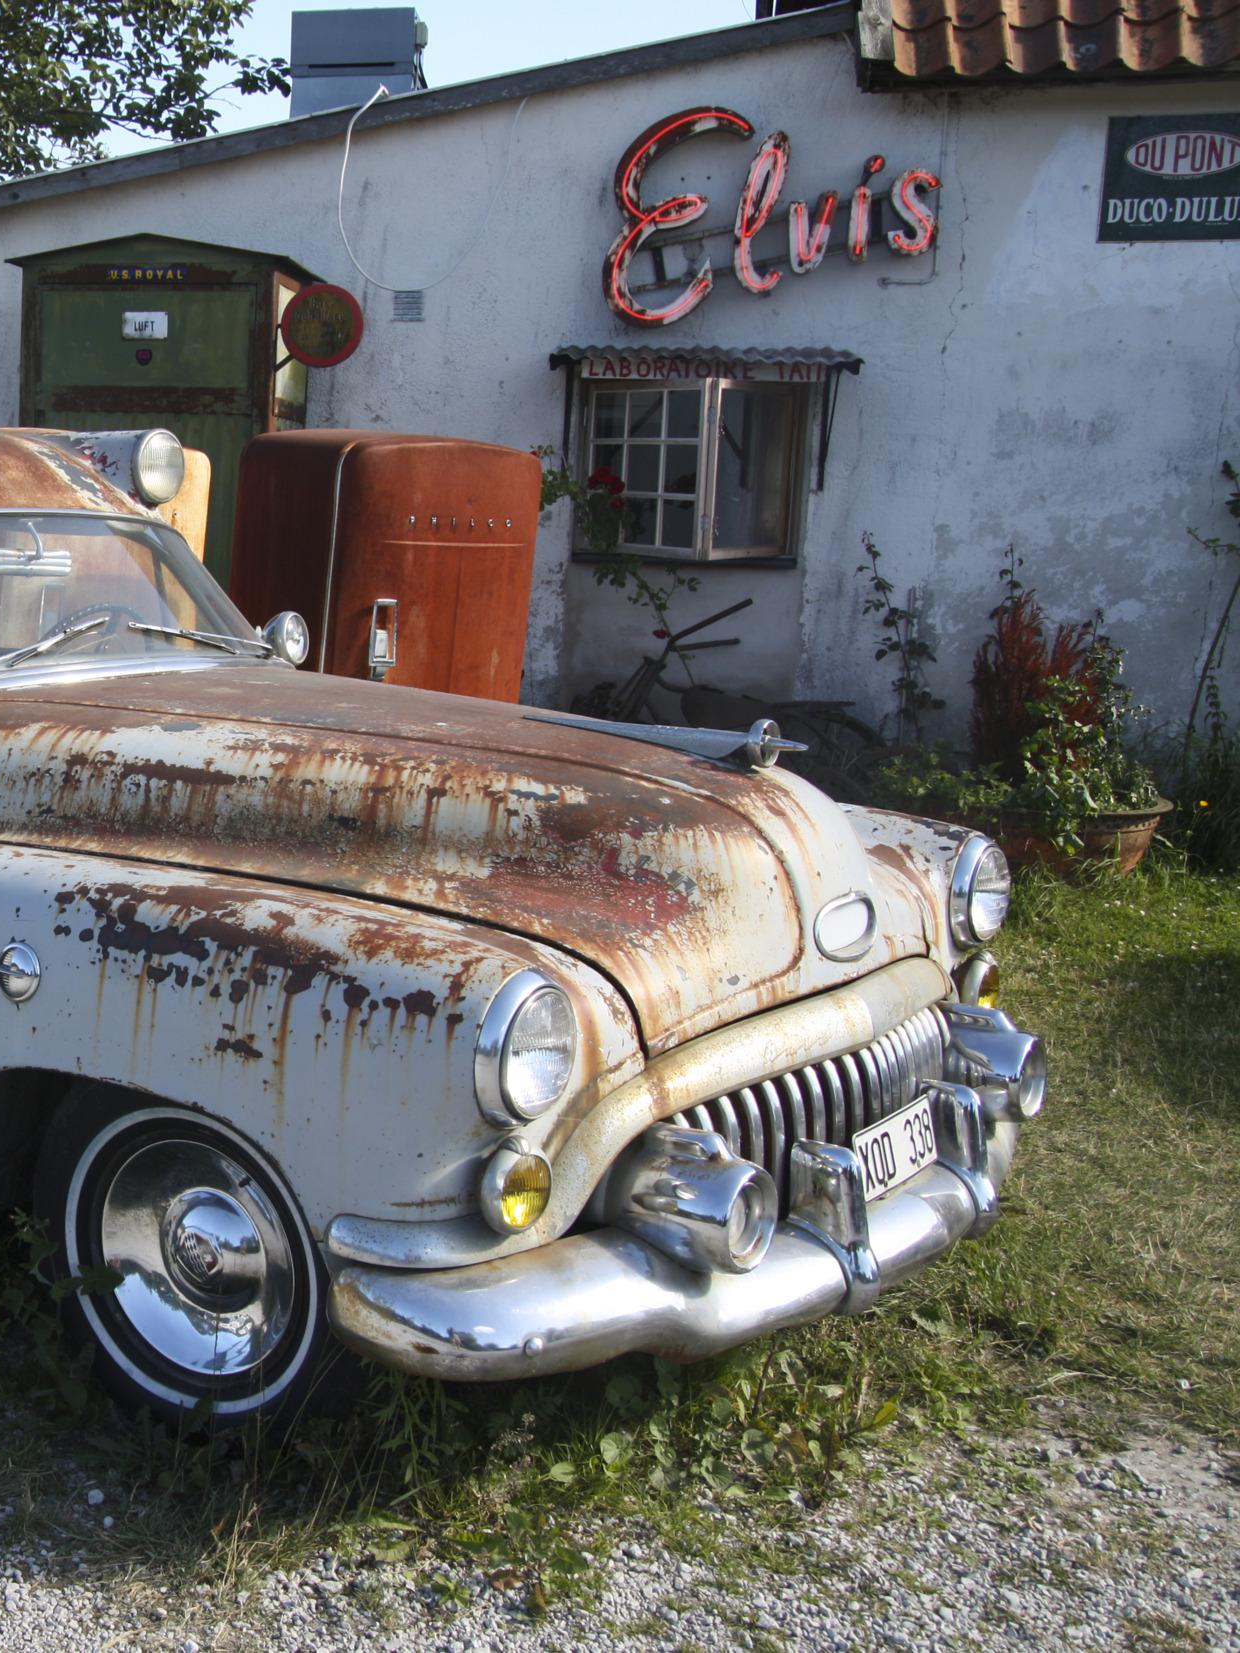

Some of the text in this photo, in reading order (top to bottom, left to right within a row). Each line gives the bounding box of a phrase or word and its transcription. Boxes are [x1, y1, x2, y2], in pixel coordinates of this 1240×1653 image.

[1135, 134, 1240, 173] DU PONT
[602, 105, 942, 328] Elvis
[135, 269, 183, 280] ROYAL
[134, 320, 155, 332] LUFT
[408, 515, 512, 528] PHILCO
[904, 1108, 934, 1165] 338
